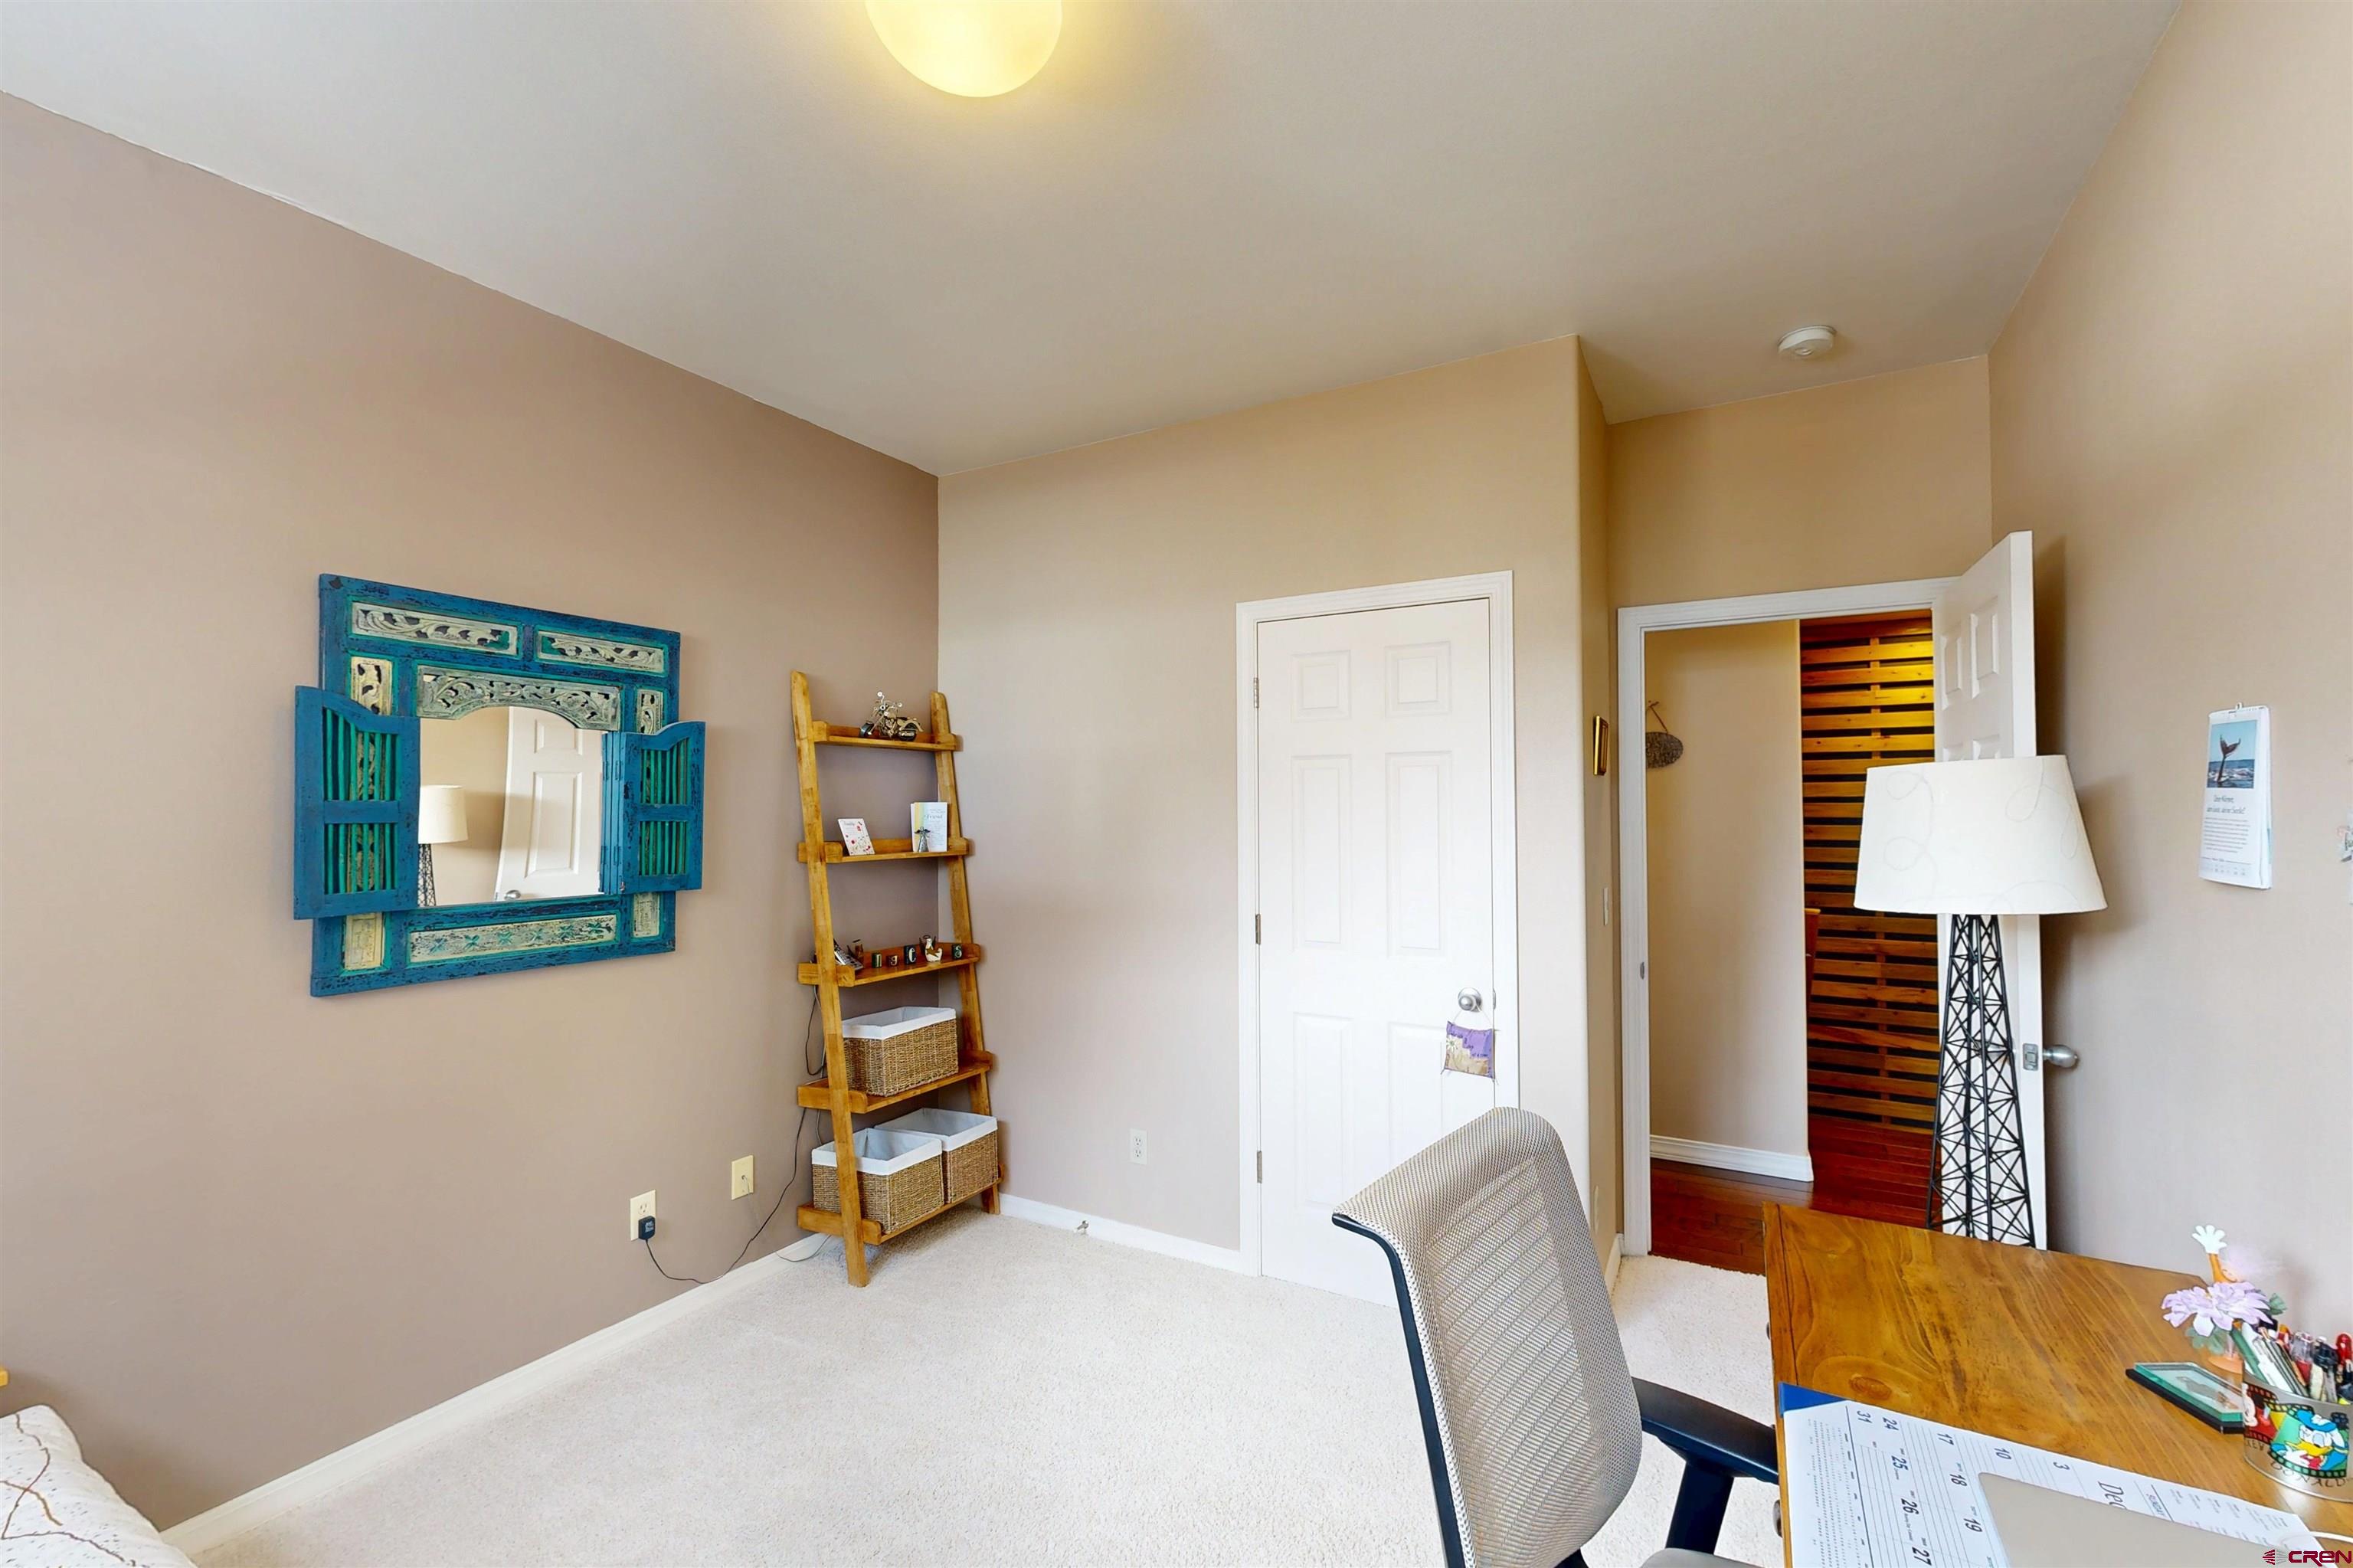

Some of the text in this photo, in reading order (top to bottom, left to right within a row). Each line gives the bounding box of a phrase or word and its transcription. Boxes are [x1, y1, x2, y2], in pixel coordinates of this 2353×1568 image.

[1857, 1410, 1873, 1423] 31
[1883, 1417, 1899, 1431] 24
[1936, 1432, 1955, 1445] 17
[1994, 1448, 2012, 1460] 10
[1891, 1455, 1909, 1471] 25
[2053, 1462, 2070, 1471] 3
[1949, 1472, 1968, 1487] 18
[1901, 1498, 1919, 1514] 26
[1963, 1517, 1983, 1533] 19
[1912, 1547, 1932, 1566] 27
